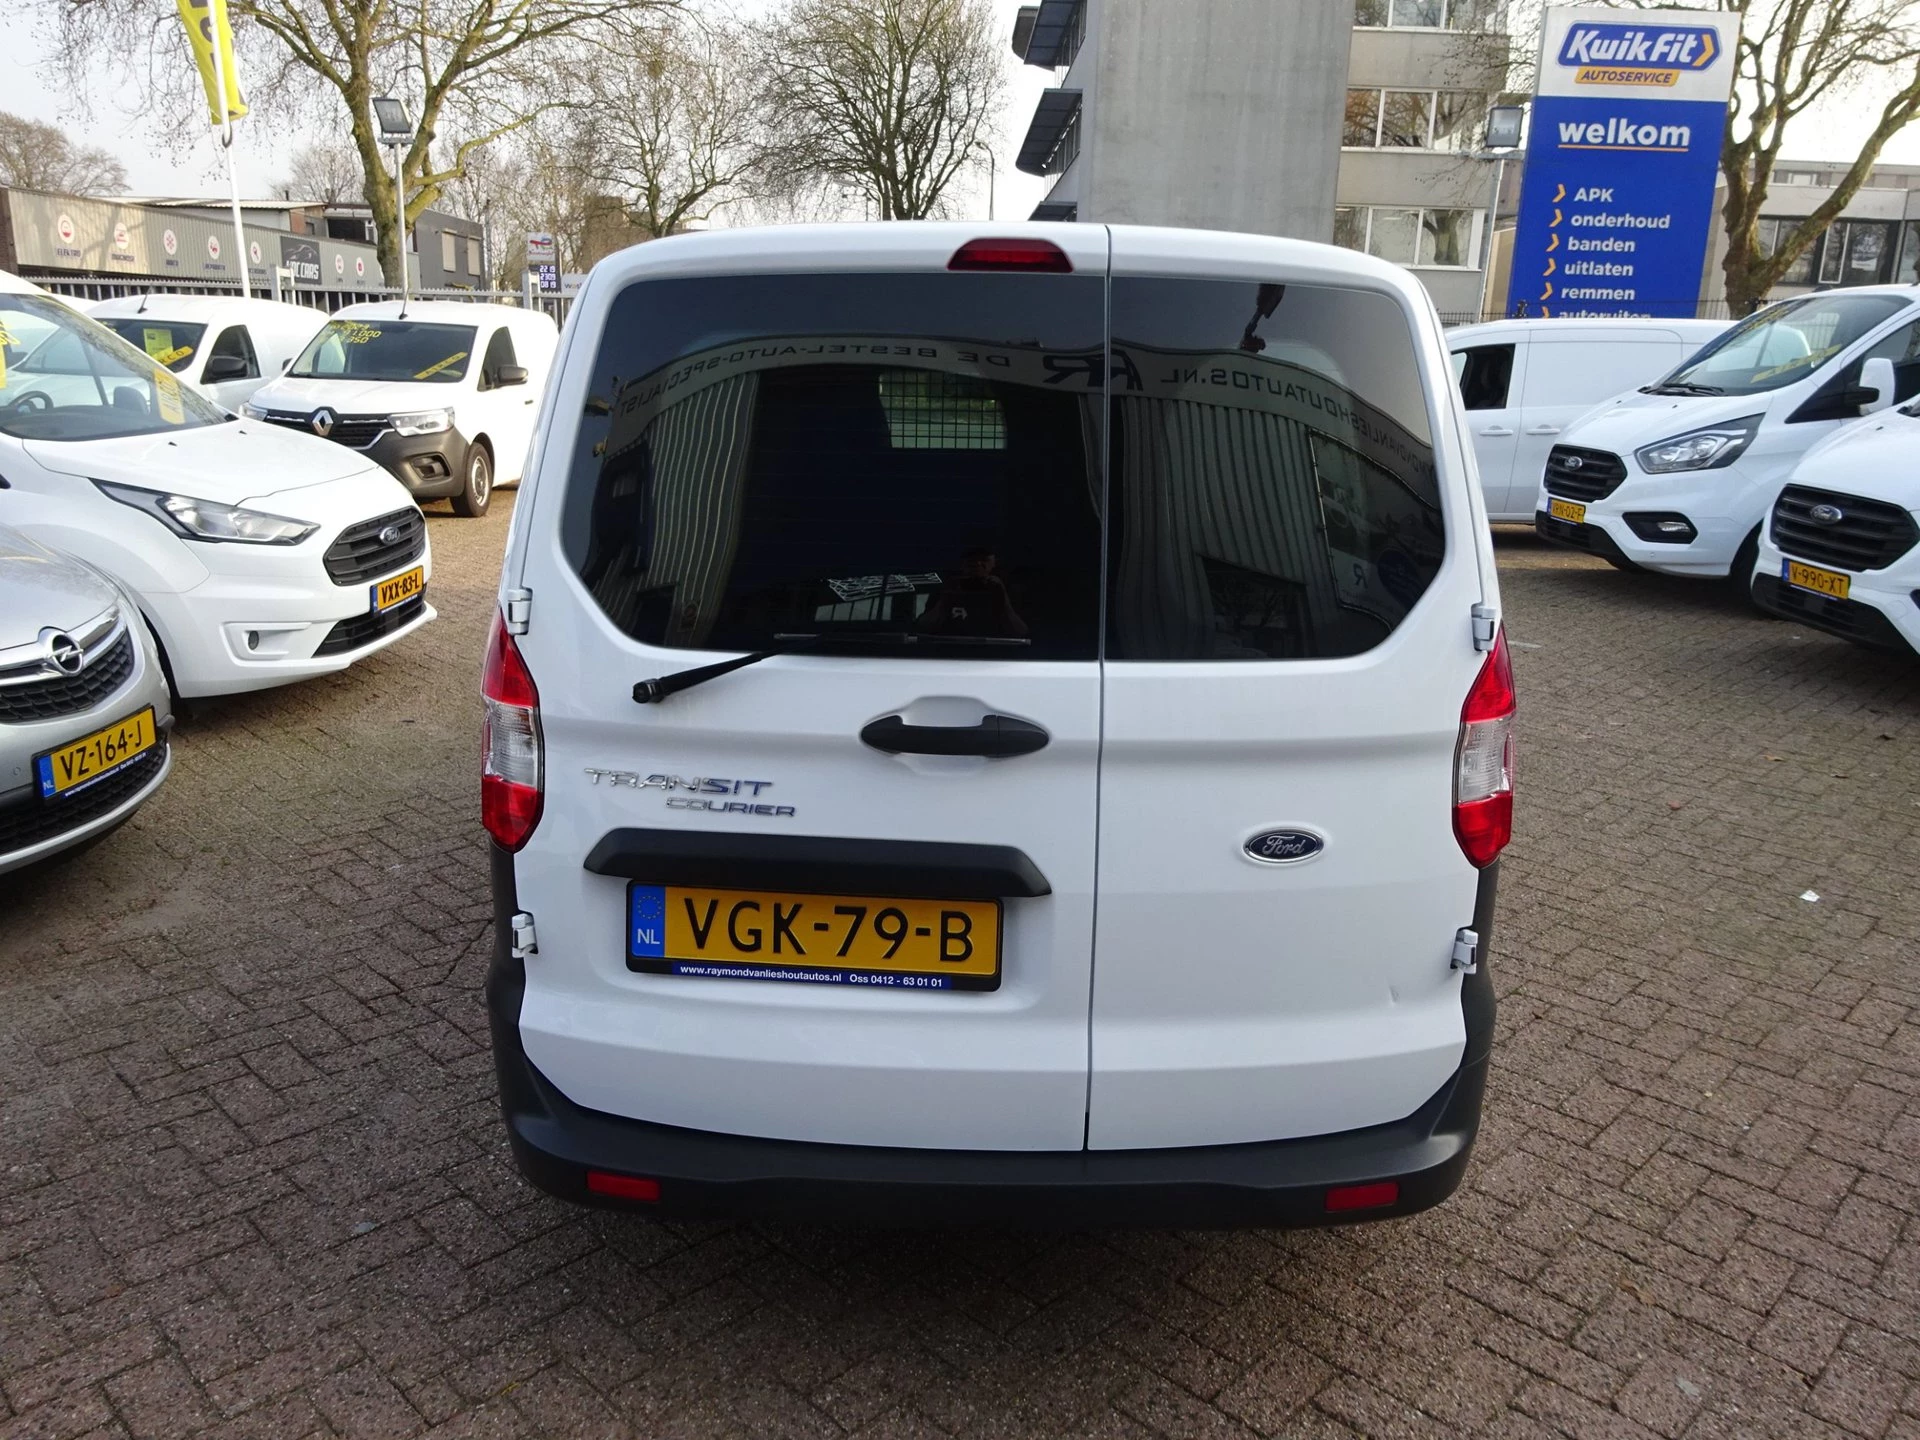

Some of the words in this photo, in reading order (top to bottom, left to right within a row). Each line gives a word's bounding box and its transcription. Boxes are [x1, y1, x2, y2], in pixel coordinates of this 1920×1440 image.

[1581, 70, 1673, 83] AUTOSERVICE
[1558, 118, 1690, 146] welkom
[1574, 187, 1614, 202] APK
[1571, 213, 1671, 229] onderhoud
[1568, 236, 1635, 252] banden
[300, 262, 319, 280] CARS
[1565, 260, 1634, 276] uitlaten
[1561, 287, 1635, 300] remmen
[60, 720, 143, 781] VZ-164-J
[584, 767, 773, 796] TRANSIT
[666, 796, 796, 817] COURIER
[1262, 835, 1306, 855] Ford
[636, 928, 661, 945] NL
[684, 897, 974, 963] VGK-79-B
[680, 965, 842, 982] www.raymondvanlieshoutautos.nl
[849, 974, 869, 984] Oss
[870, 974, 894, 985] 0412
[903, 976, 915, 986] 63
[917, 976, 929, 987] 01
[931, 977, 943, 987] 01
